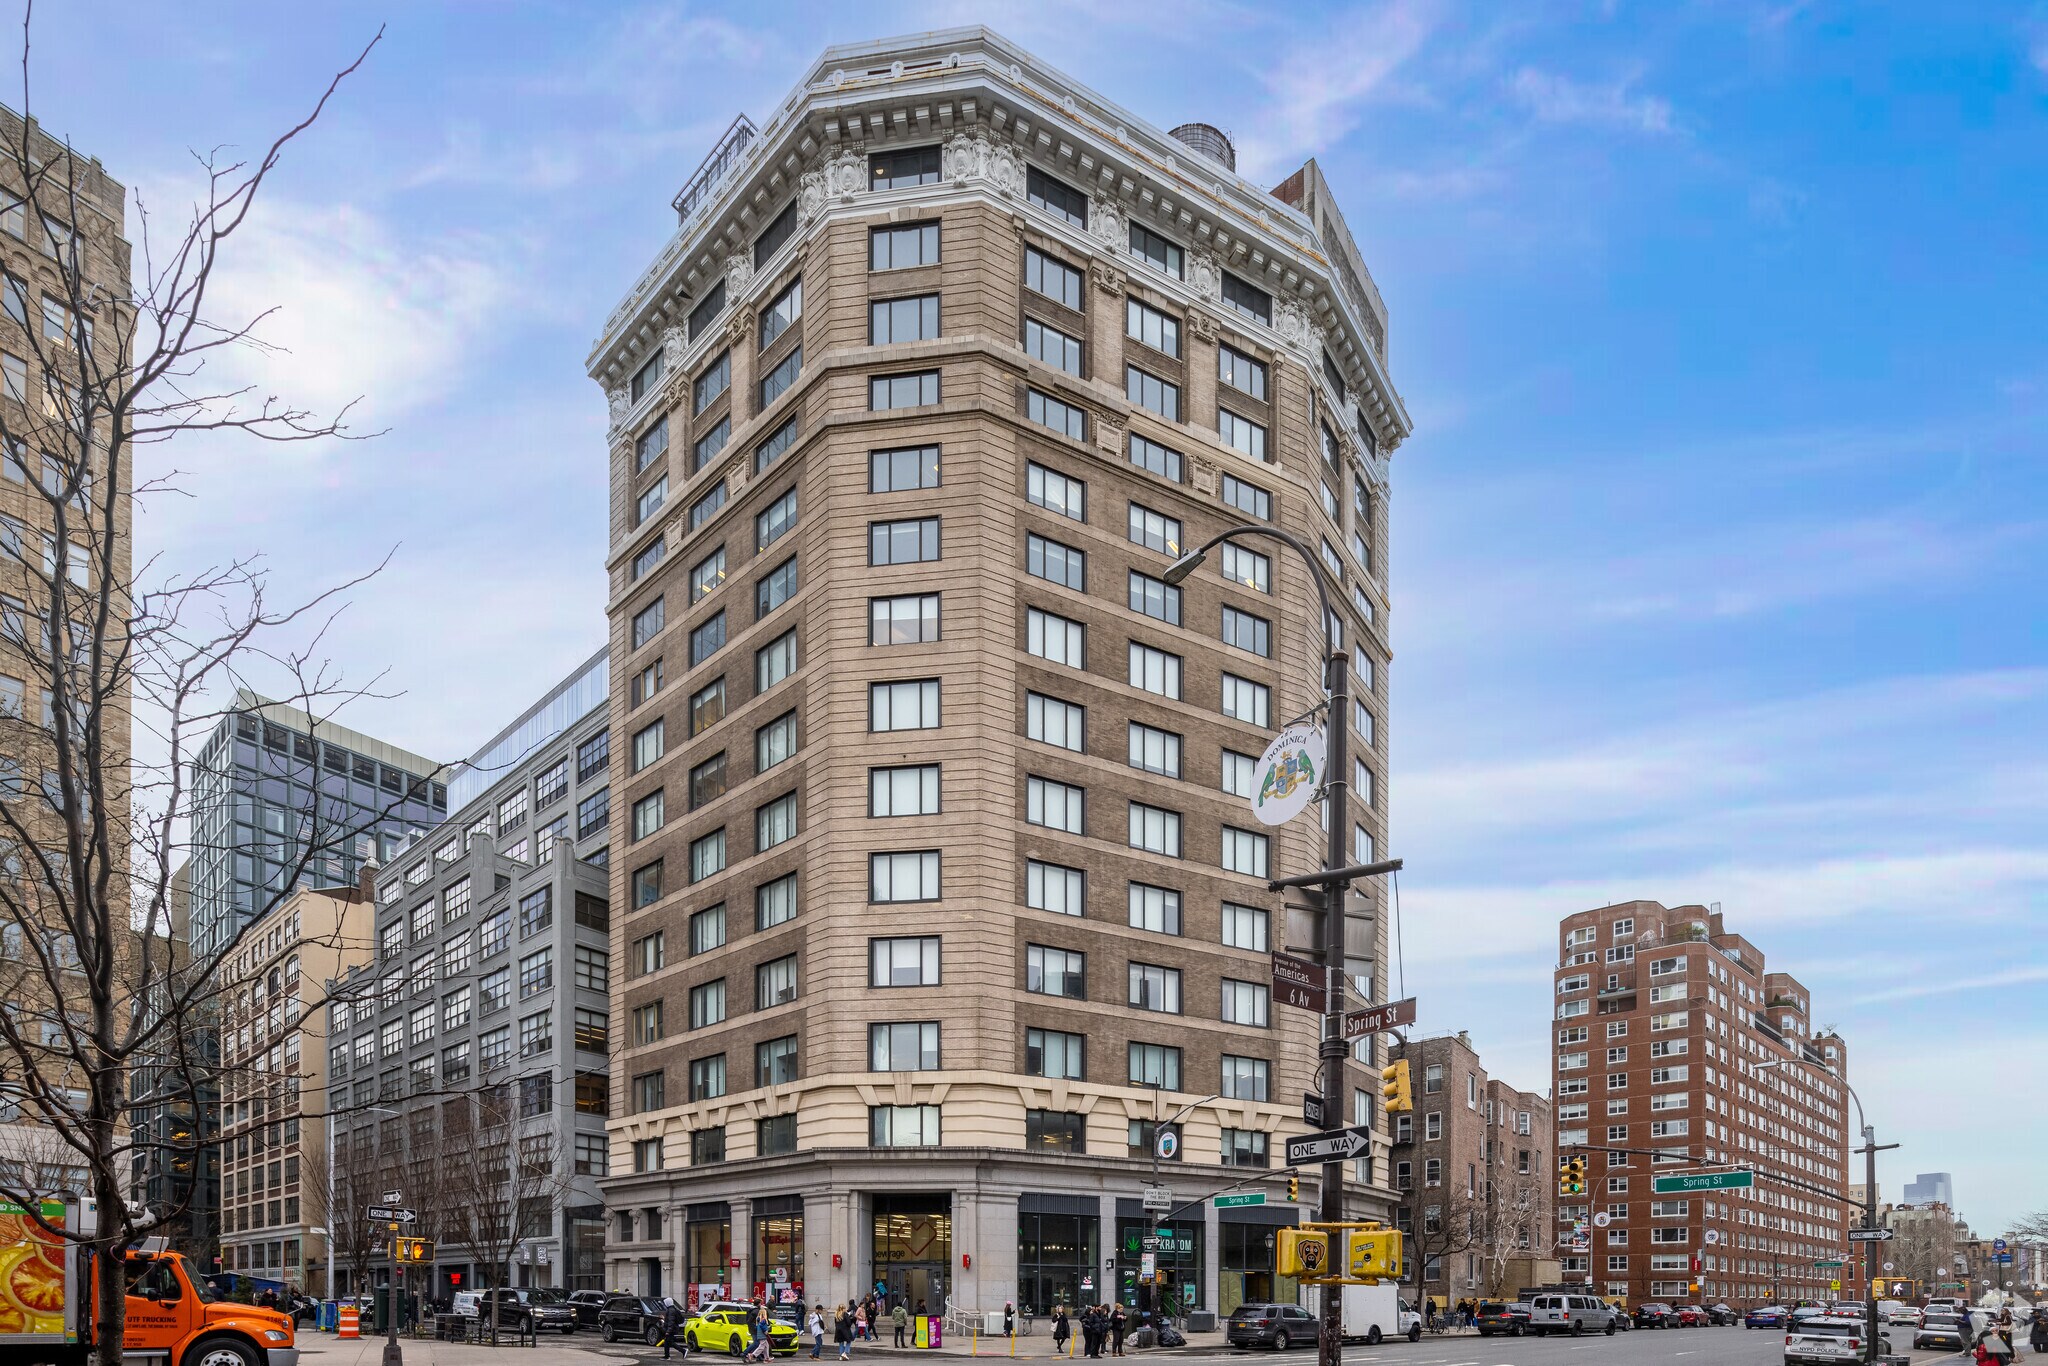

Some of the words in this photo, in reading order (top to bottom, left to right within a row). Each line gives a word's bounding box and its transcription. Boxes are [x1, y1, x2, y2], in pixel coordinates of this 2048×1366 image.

[1267, 735, 1307, 761] DOMINICA
[1274, 957, 1289, 966] Avenue
[1274, 964, 1310, 983] Americas
[1290, 989, 1295, 1003] 6
[1299, 991, 1310, 1007] Av
[1347, 1013, 1381, 1034] Spring
[1386, 1007, 1398, 1023] St
[1306, 1103, 1319, 1119] ONE
[1293, 1143, 1317, 1157] ONE
[1330, 1136, 1358, 1152] WAY
[1683, 1178, 1710, 1188] Spring
[1713, 1176, 1723, 1184] St
[1229, 1197, 1244, 1205] Spring
[1160, 1239, 1192, 1250] KRAOM
[875, 1250, 905, 1259] evrage
